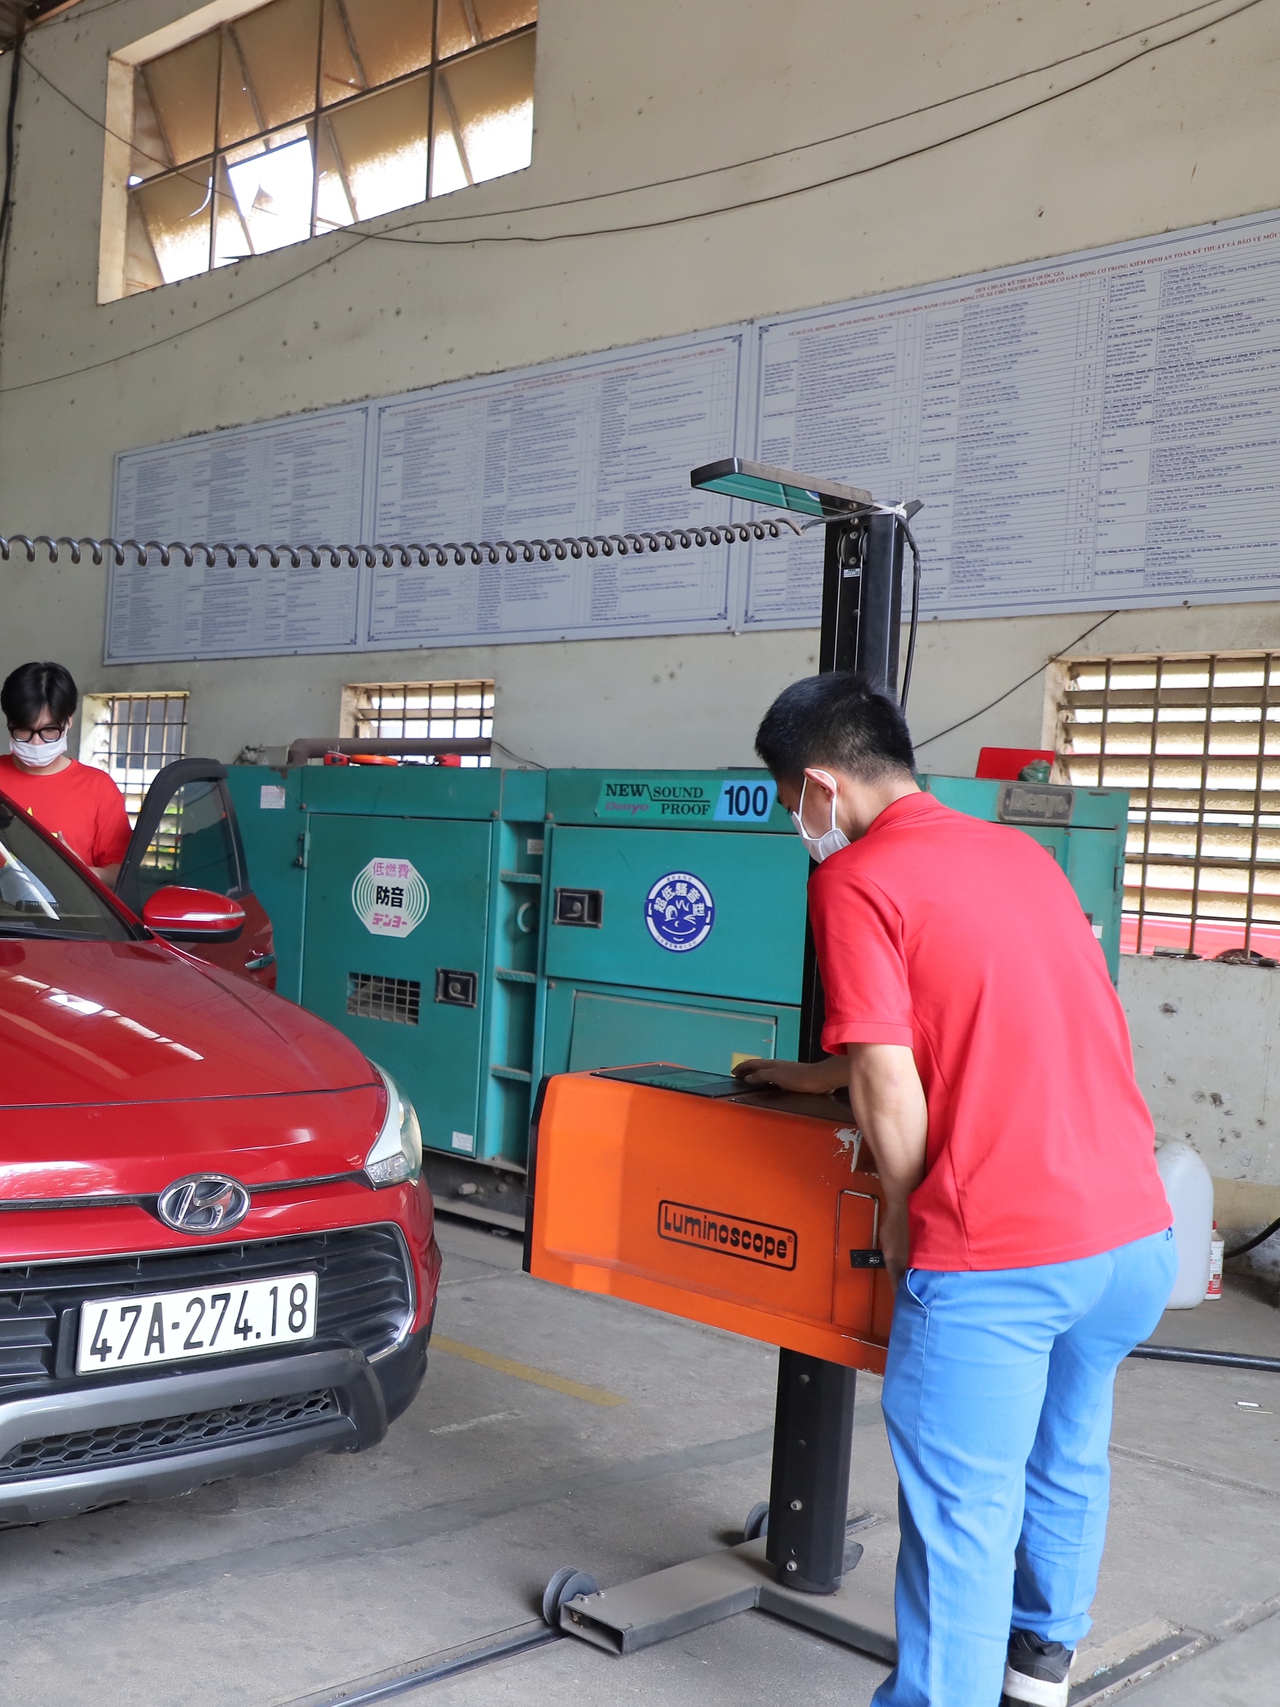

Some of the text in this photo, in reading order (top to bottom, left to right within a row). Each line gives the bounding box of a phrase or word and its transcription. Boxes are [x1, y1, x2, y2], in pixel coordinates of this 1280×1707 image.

[1107, 262, 1128, 271] TRONG
[605, 784, 704, 798] NEW SOUND
[605, 802, 649, 815] Denyo
[660, 803, 710, 815] PROOF
[724, 785, 768, 817] 100
[373, 862, 410, 879] 低燃費
[376, 885, 404, 908] 防音
[372, 912, 408, 928] デンヨー
[664, 1206, 788, 1259] Luminoscope
[89, 1282, 308, 1362] 47A-274.18
